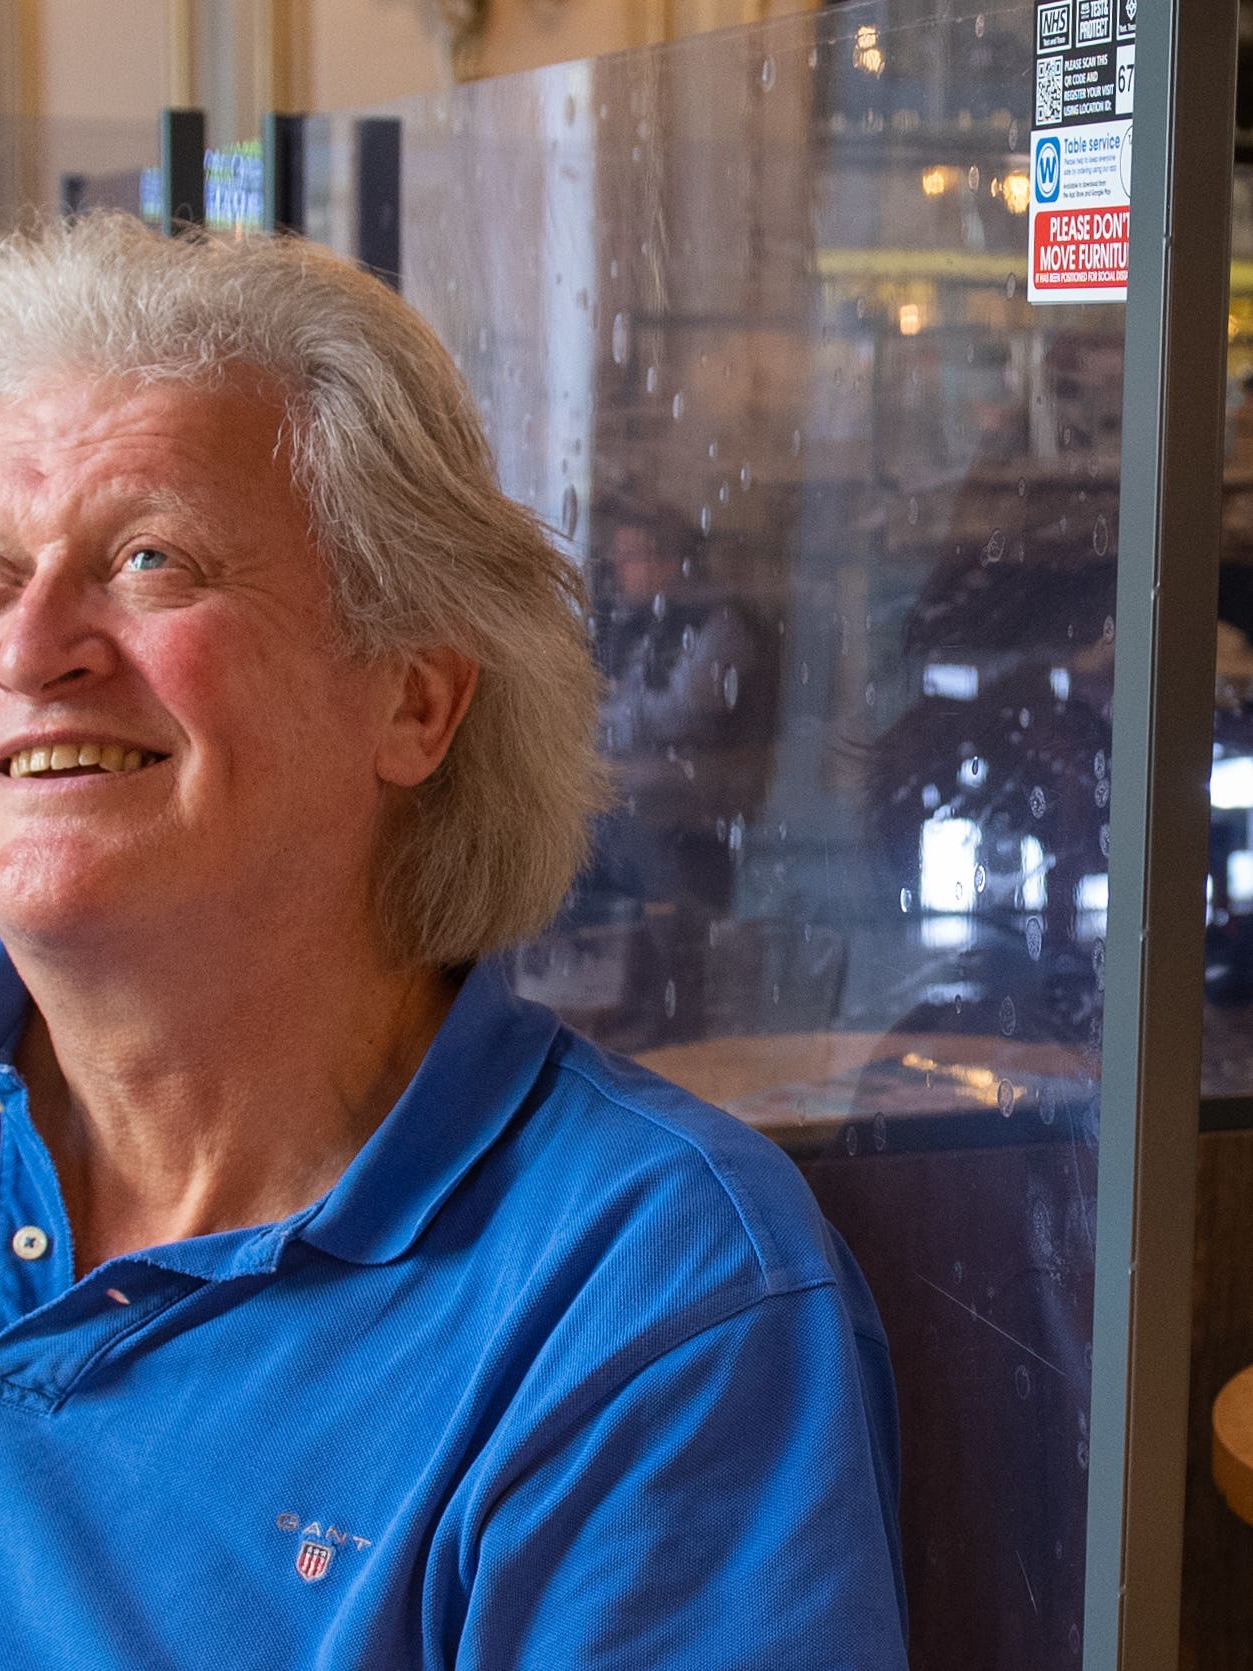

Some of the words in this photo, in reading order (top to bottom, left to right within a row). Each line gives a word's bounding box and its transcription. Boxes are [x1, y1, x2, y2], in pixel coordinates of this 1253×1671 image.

[1043, 8, 1066, 35] NHS
[1079, 17, 1108, 41] PROTECT
[1064, 58, 1082, 71] PLEASE
[1082, 56, 1097, 69] SCAN
[1097, 54, 1108, 66] THIS
[1064, 75, 1072, 88] QR
[1072, 73, 1086, 85] CODE
[1086, 71, 1098, 82] AND
[1118, 64, 1135, 93] 67
[1064, 88, 1086, 101] REGISTER
[1086, 86, 1102, 98] YOUR
[1102, 84, 1115, 96] VISIT
[1064, 104, 1079, 116] USING
[1079, 101, 1104, 115] LOCATION
[1064, 137, 1086, 154] Table
[1089, 132, 1121, 152] service
[1040, 157, 1056, 183] W
[1049, 214, 1091, 242] PLEASE
[1040, 244, 1076, 271] MOVE
[1079, 241, 1129, 270] FURNITU
[1061, 271, 1087, 282] POSITIONED
[1097, 270, 1115, 281] SOCIAL
[275, 1512, 371, 1551] GANT
